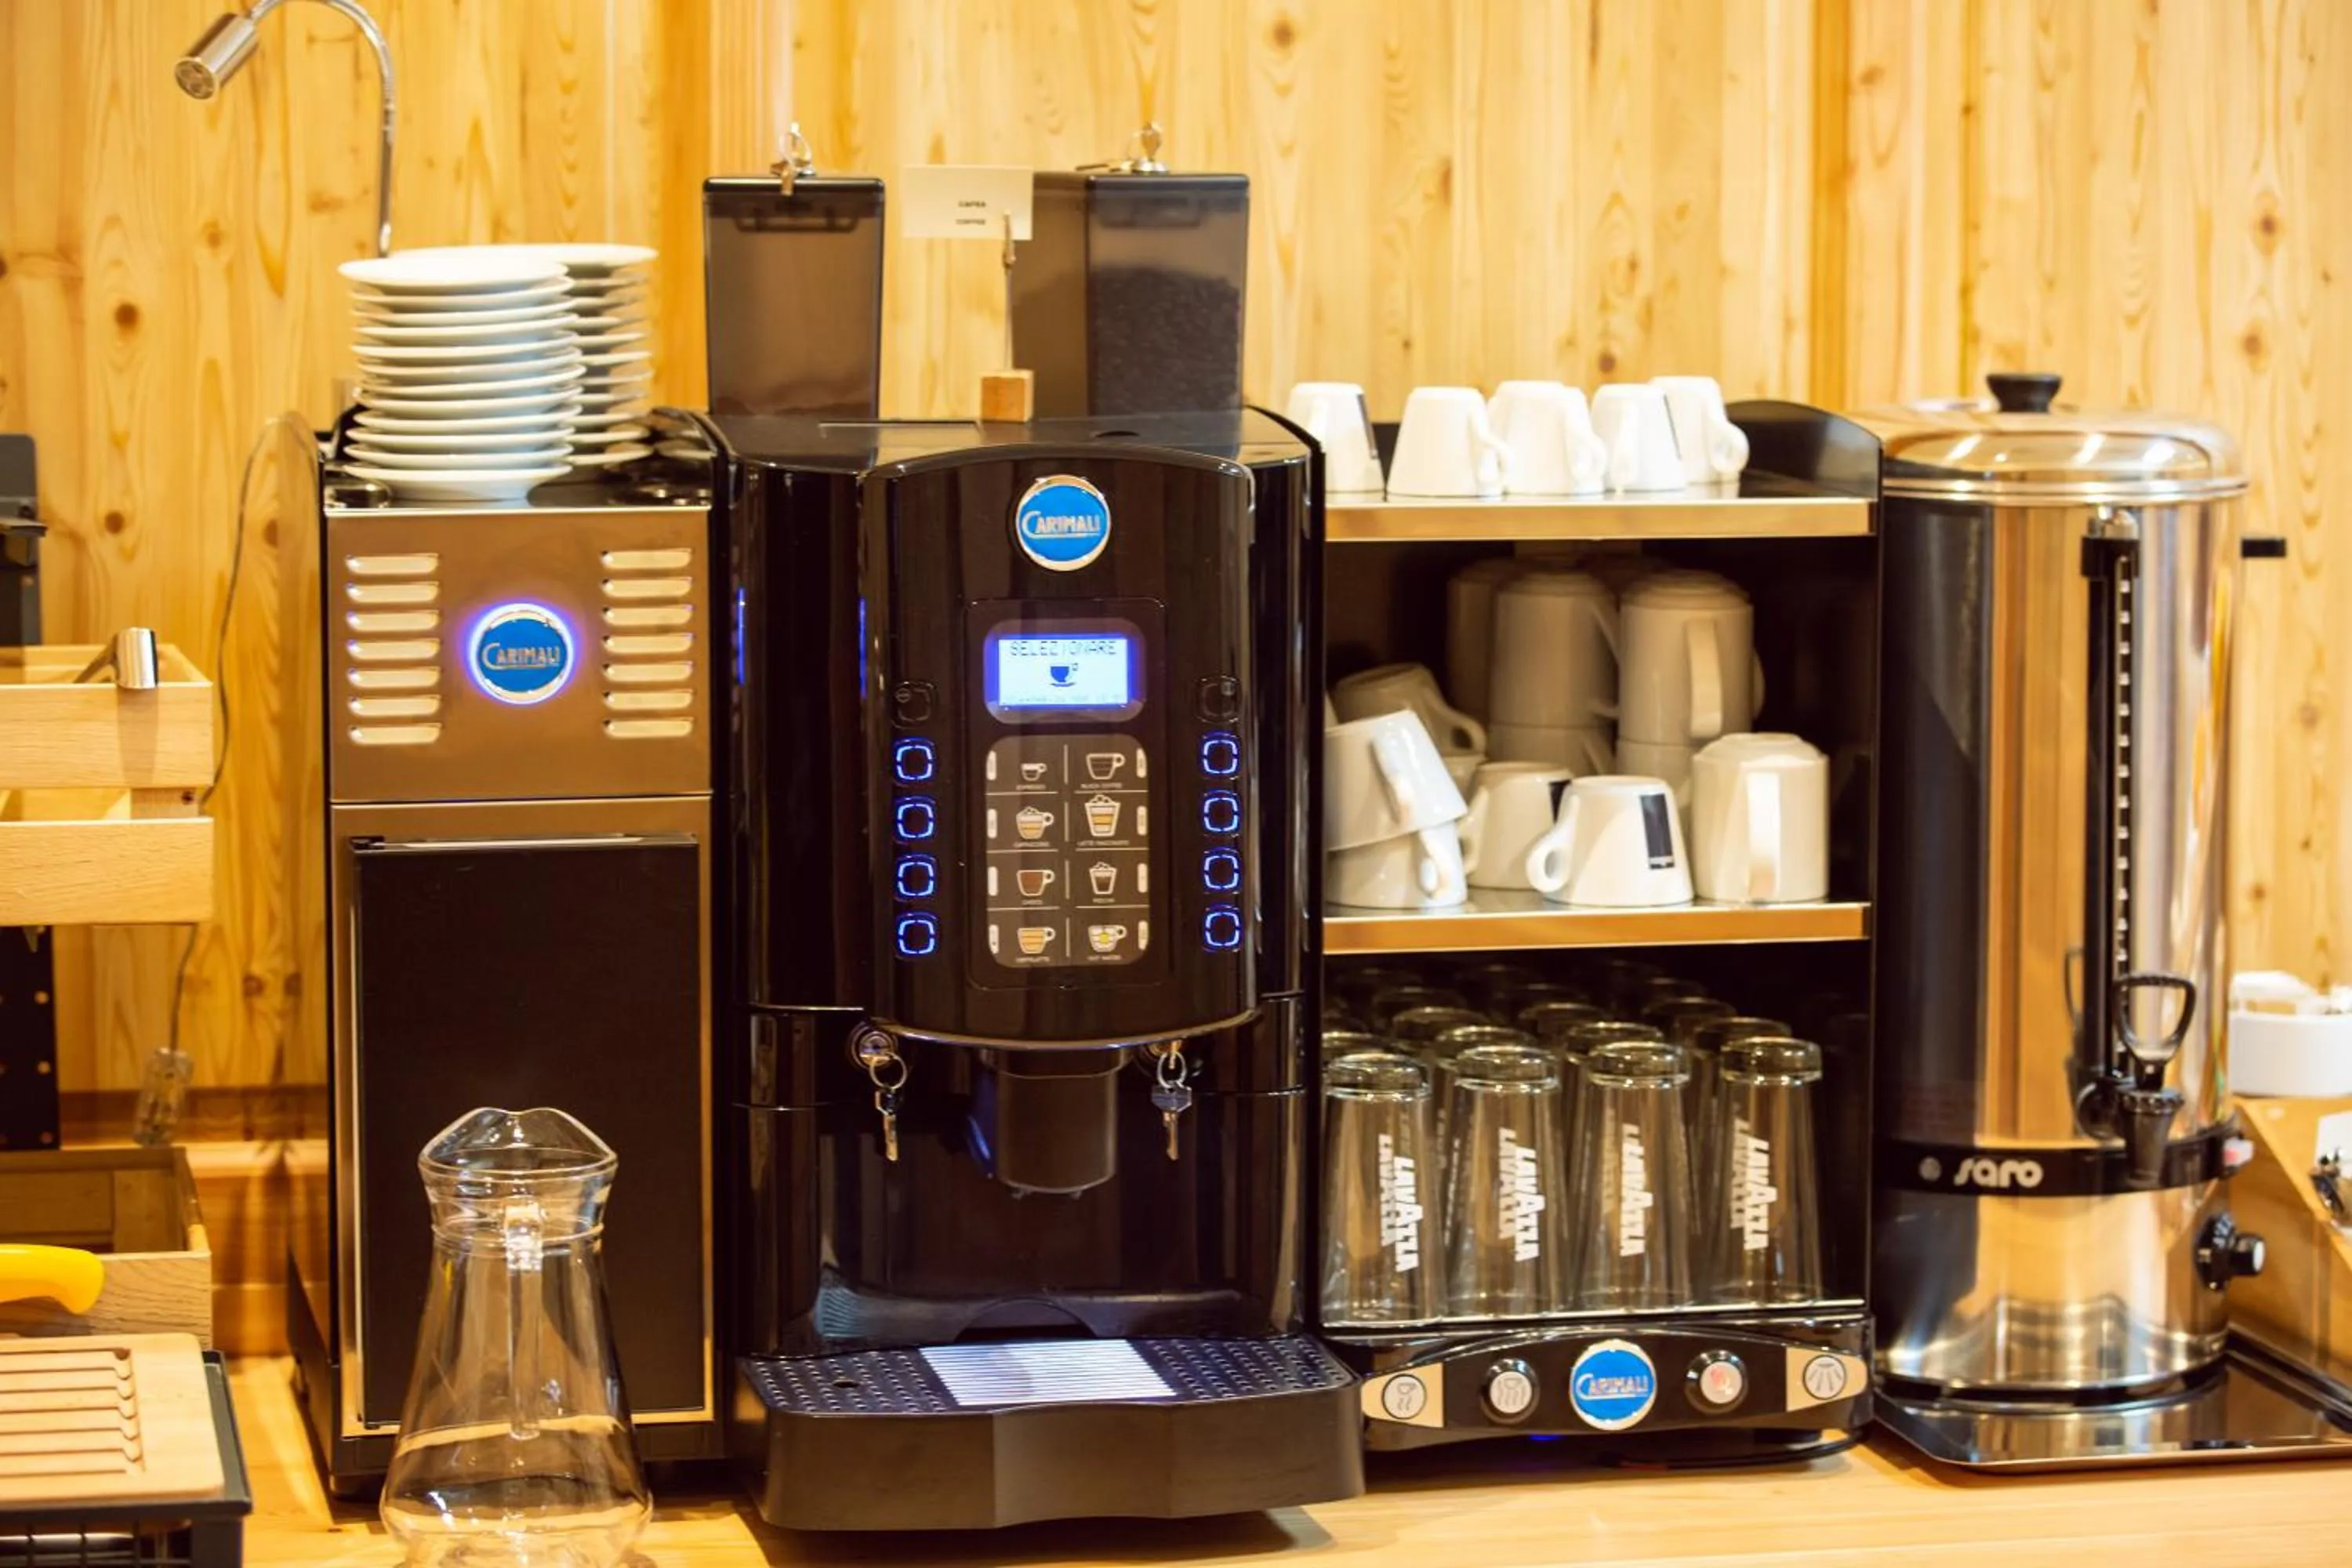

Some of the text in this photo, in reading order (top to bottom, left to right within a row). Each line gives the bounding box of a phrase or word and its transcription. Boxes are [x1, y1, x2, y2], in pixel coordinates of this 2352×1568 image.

[1393, 1156, 1423, 1272] LAVAZZA
[1515, 1145, 1545, 1262] LAVAZZA
[1620, 1142, 1653, 1257] LAVAZZA
[1744, 1137, 1777, 1250] LAVAZZA
[1954, 1158, 2043, 1188] saro
